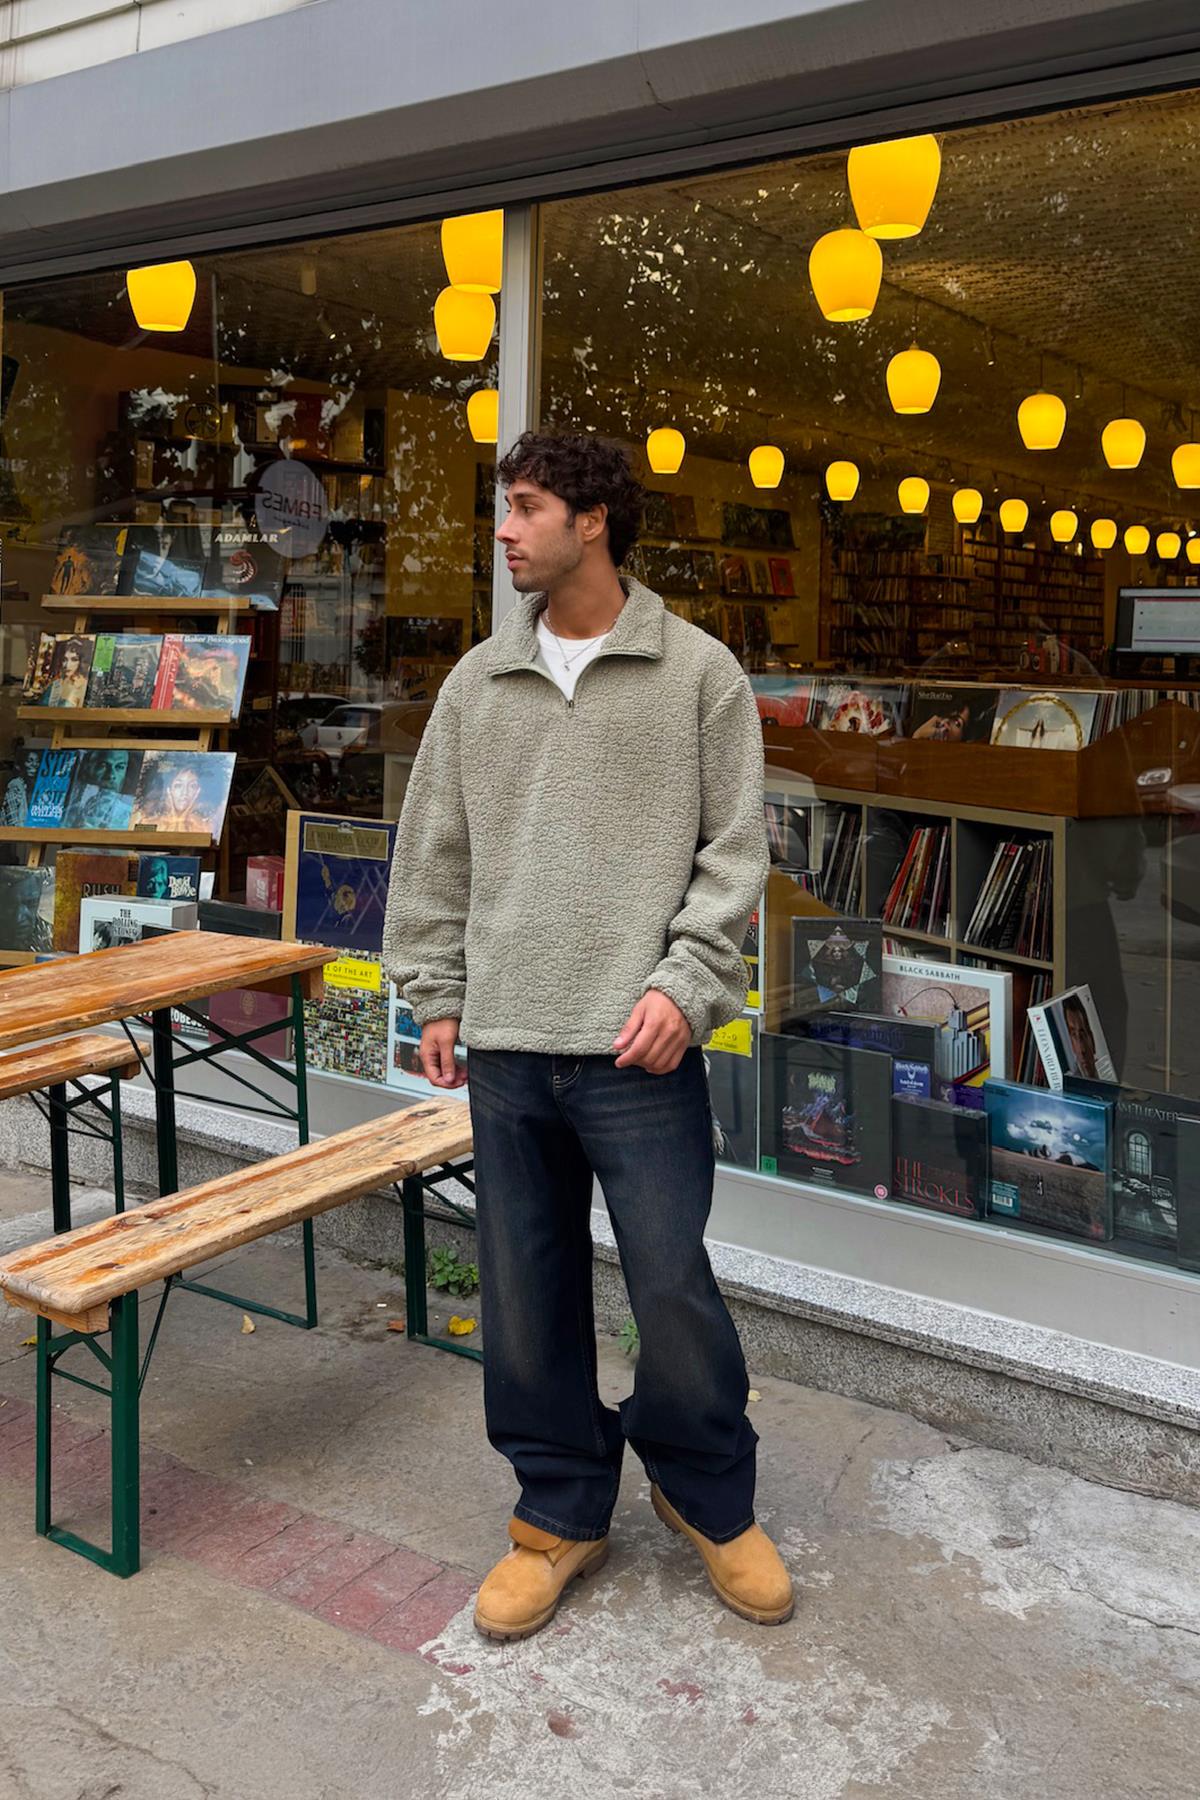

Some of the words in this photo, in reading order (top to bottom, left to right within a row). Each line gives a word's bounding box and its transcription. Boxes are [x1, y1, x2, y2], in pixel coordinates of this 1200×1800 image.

[214, 533, 279, 543] ADAMLAR
[82, 883, 120, 897] RUSH
[120, 908, 131, 918] THE
[345, 968, 357, 976] THE
[360, 971, 373, 979] ART
[899, 964, 924, 975] BLACK
[925, 968, 960, 981] SABBATH
